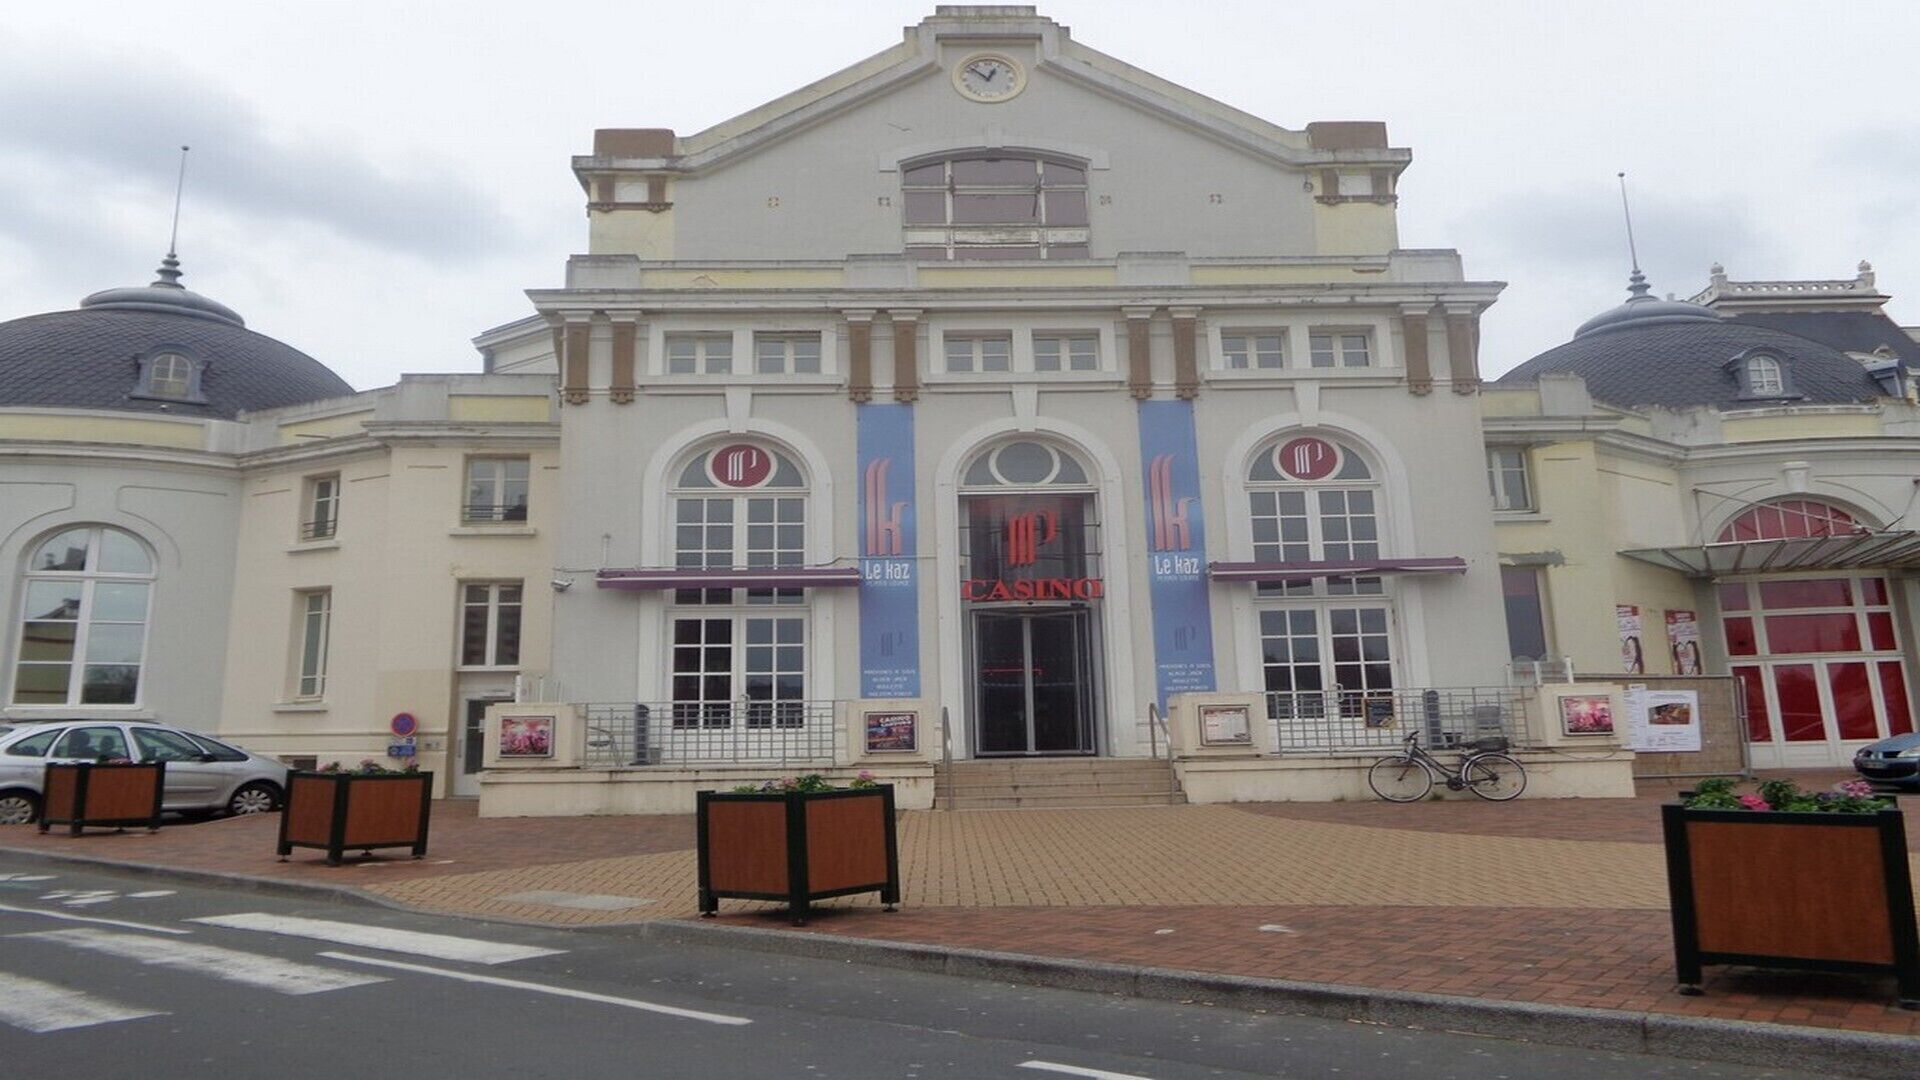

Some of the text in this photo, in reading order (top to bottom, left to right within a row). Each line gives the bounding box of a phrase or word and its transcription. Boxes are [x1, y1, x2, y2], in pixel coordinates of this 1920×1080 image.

[865, 560, 882, 580] Le
[1154, 555, 1171, 575] Le
[960, 577, 1105, 601] CASINO
